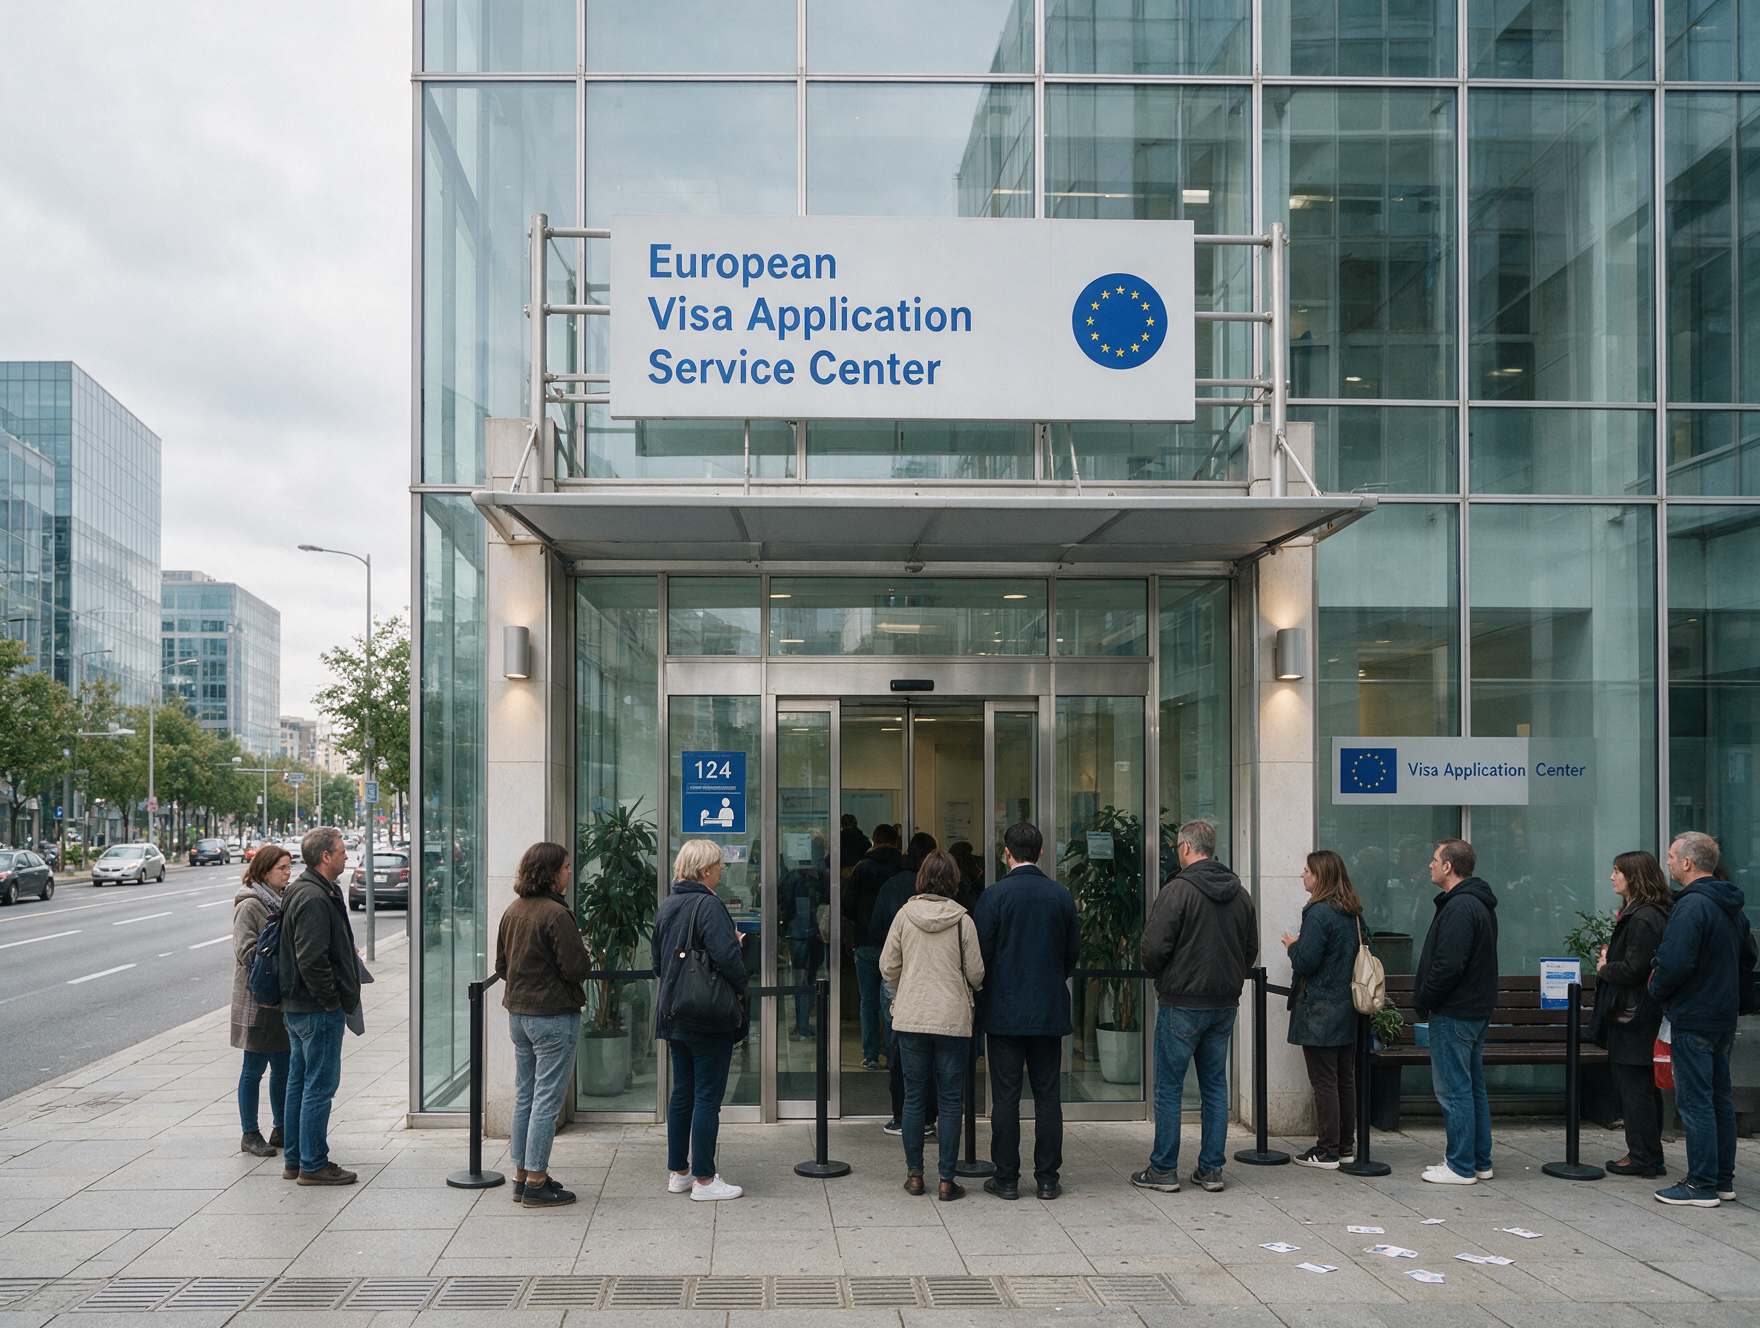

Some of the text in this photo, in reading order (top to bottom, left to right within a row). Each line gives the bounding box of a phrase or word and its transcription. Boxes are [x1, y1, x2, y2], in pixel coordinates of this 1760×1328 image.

[649, 243, 837, 288] European
[648, 296, 972, 341] Visa Application
[648, 348, 942, 386] Service Center
[695, 761, 732, 779] 124
[1408, 762, 1586, 781] Visa Application Center
